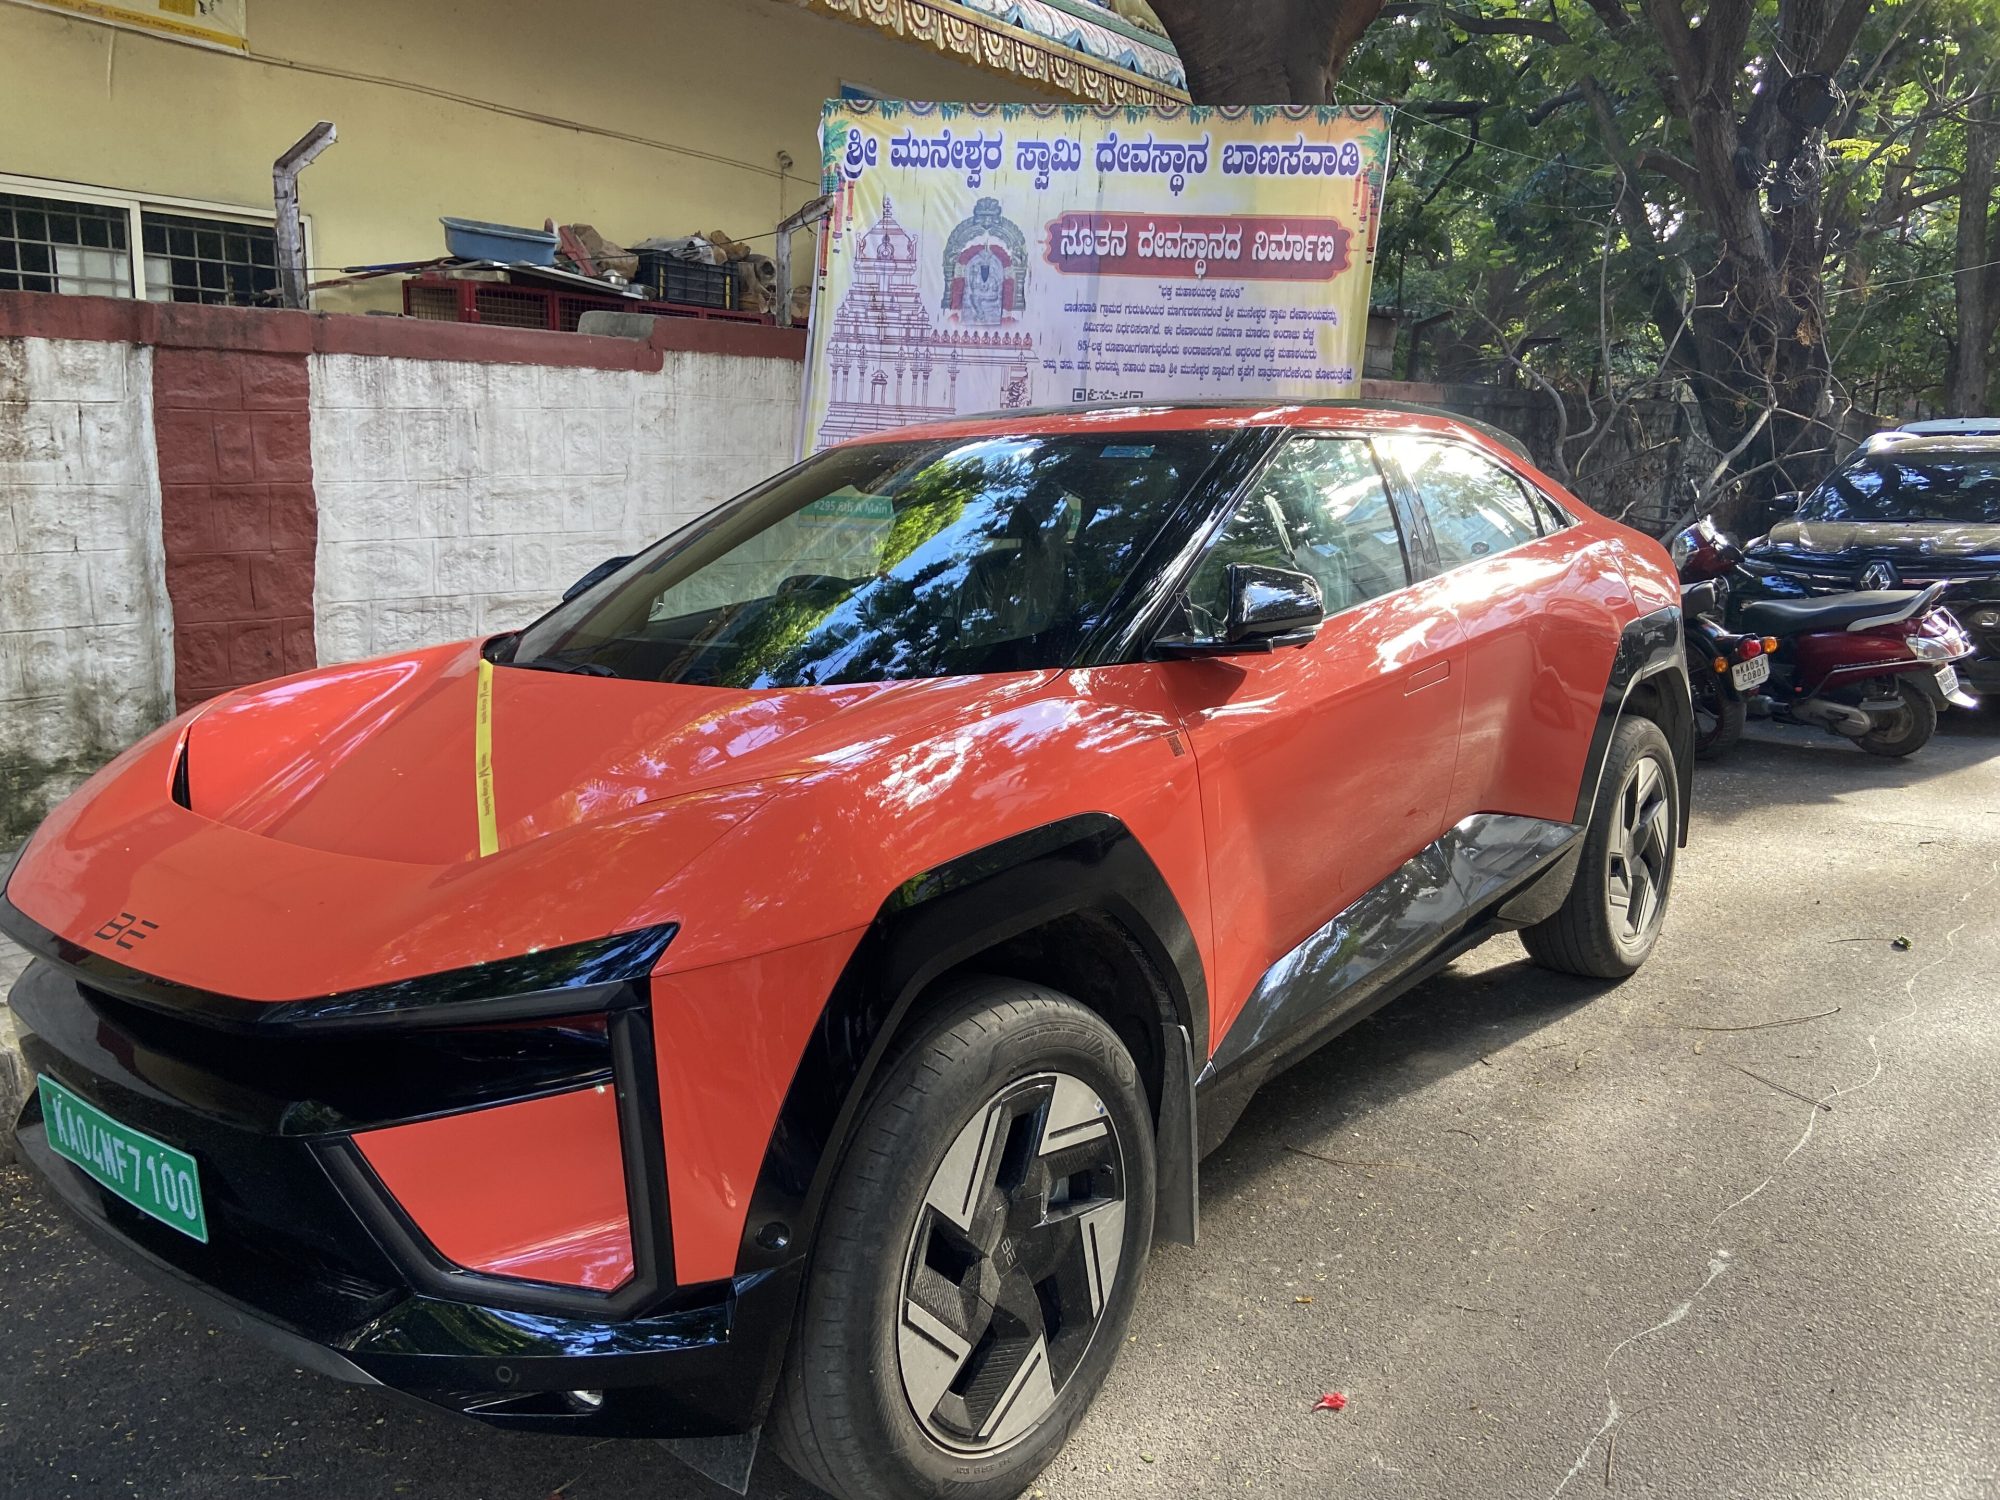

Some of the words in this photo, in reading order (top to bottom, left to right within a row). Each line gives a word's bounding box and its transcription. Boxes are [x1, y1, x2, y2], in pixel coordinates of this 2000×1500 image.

[844, 128, 877, 179] ಶ್ರೀ
[891, 128, 1003, 188] ಮುನೇಶ್ವರ
[1016, 138, 1081, 190] ಸ್ವಾಮಿ
[1095, 132, 1209, 196] ದೇವಸ್ಥಾನ
[1222, 134, 1359, 176] ಬಾಣಸವಾಡಿ
[1060, 219, 1127, 256] ನೂತನ
[1137, 221, 1242, 279] ದೇವಸ್ಥಾನದ
[1252, 224, 1335, 262] ನಿರ್ಮಾಣ
[865, 502, 888, 514] Main
